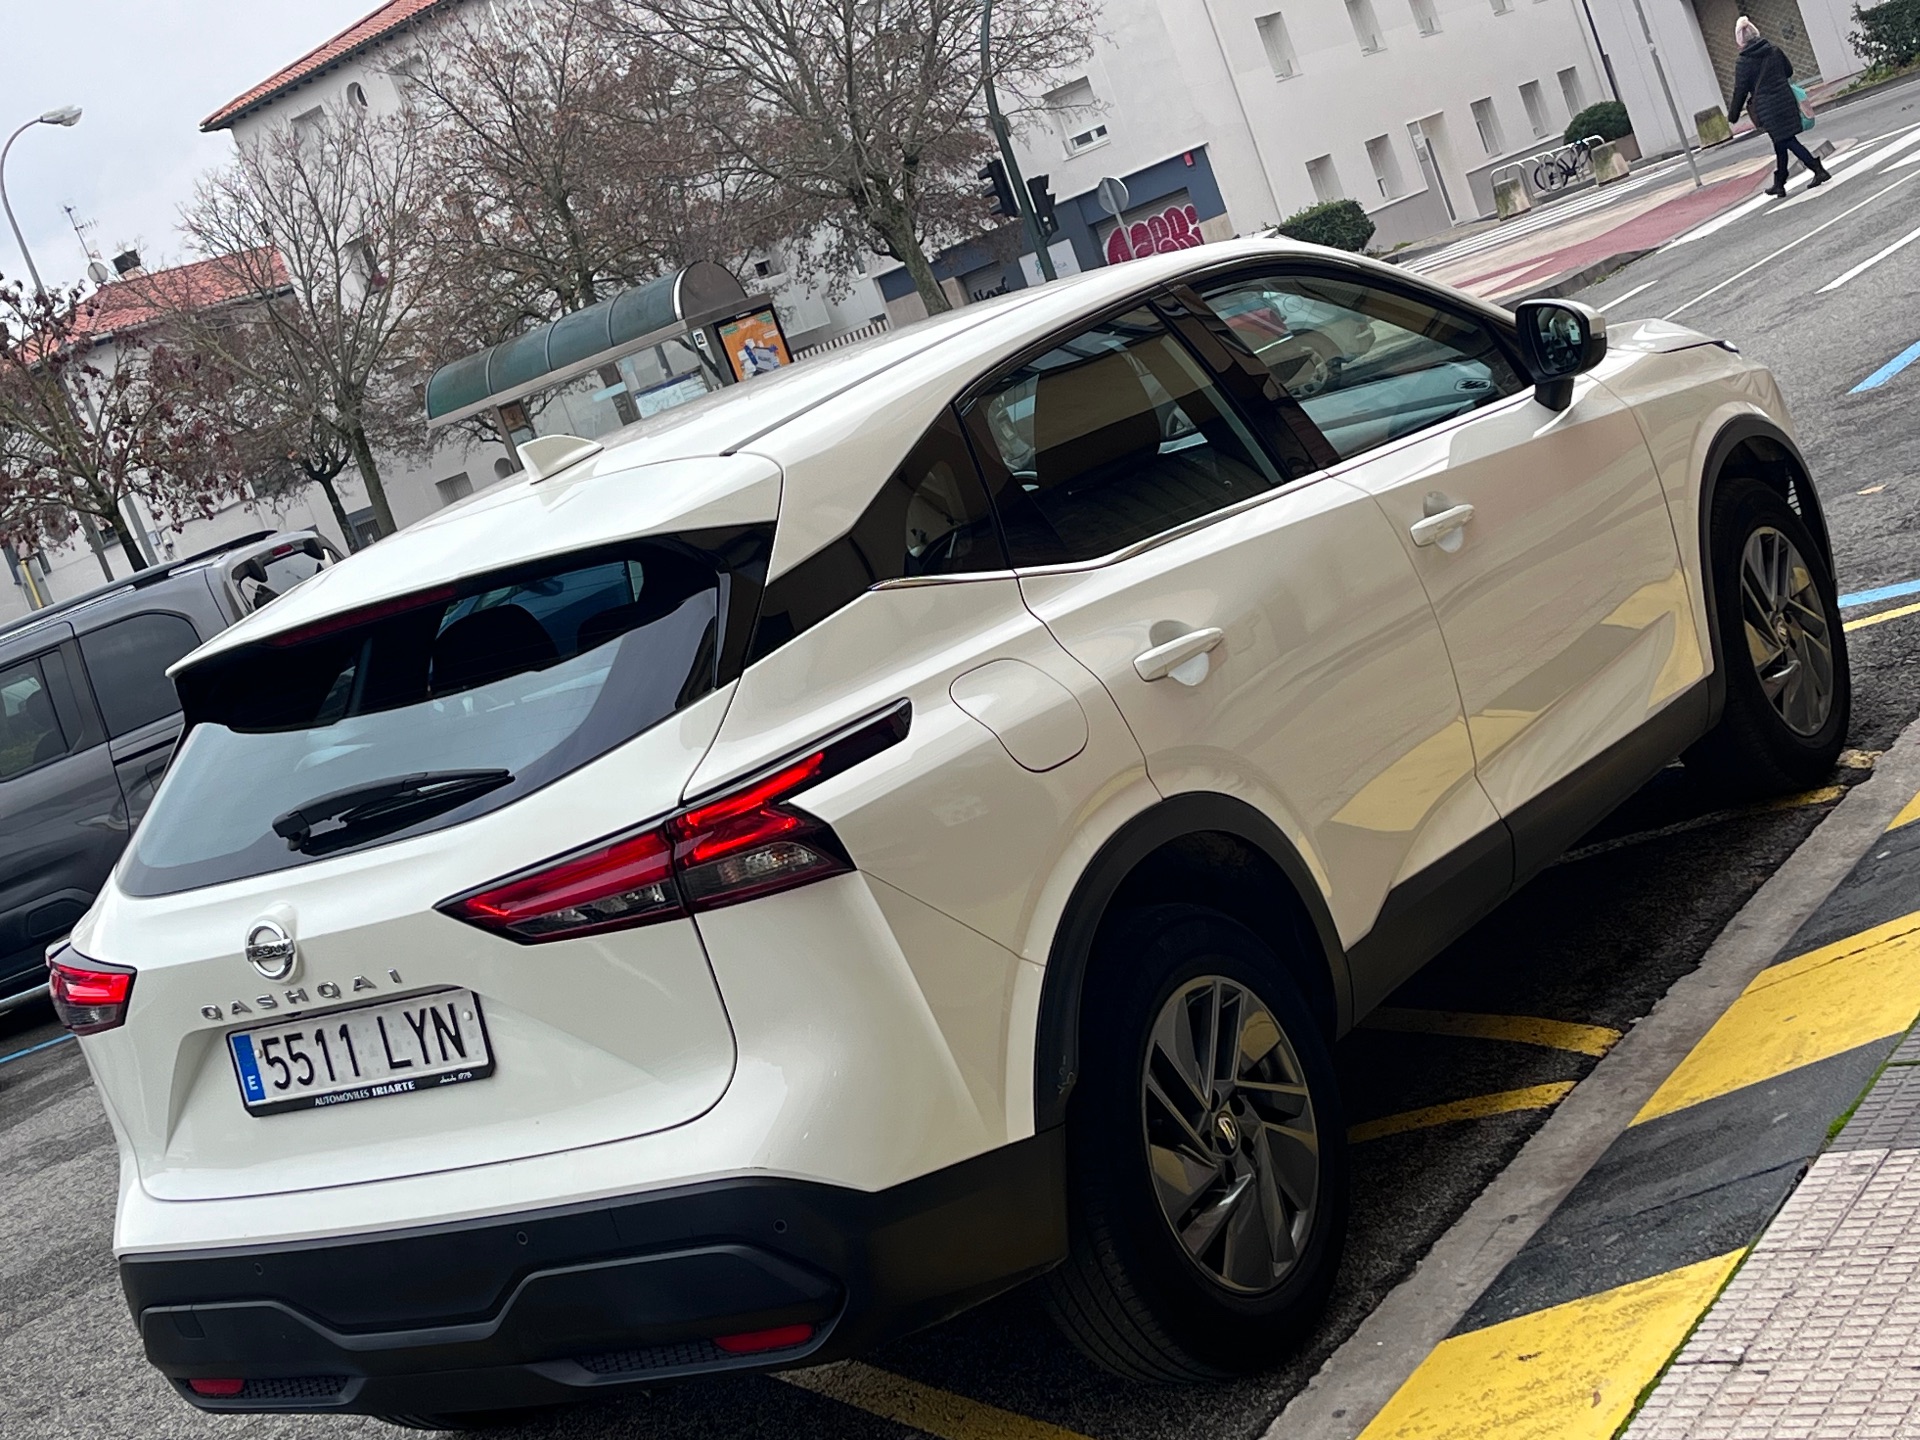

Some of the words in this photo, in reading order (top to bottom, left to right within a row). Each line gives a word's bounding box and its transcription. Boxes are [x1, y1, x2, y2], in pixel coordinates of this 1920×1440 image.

[201, 968, 402, 1021] QASHQAI
[261, 1024, 360, 1090] 5511
[377, 1003, 467, 1070] LYN
[246, 1075, 259, 1091] E
[372, 1080, 416, 1096] IRIARTE
